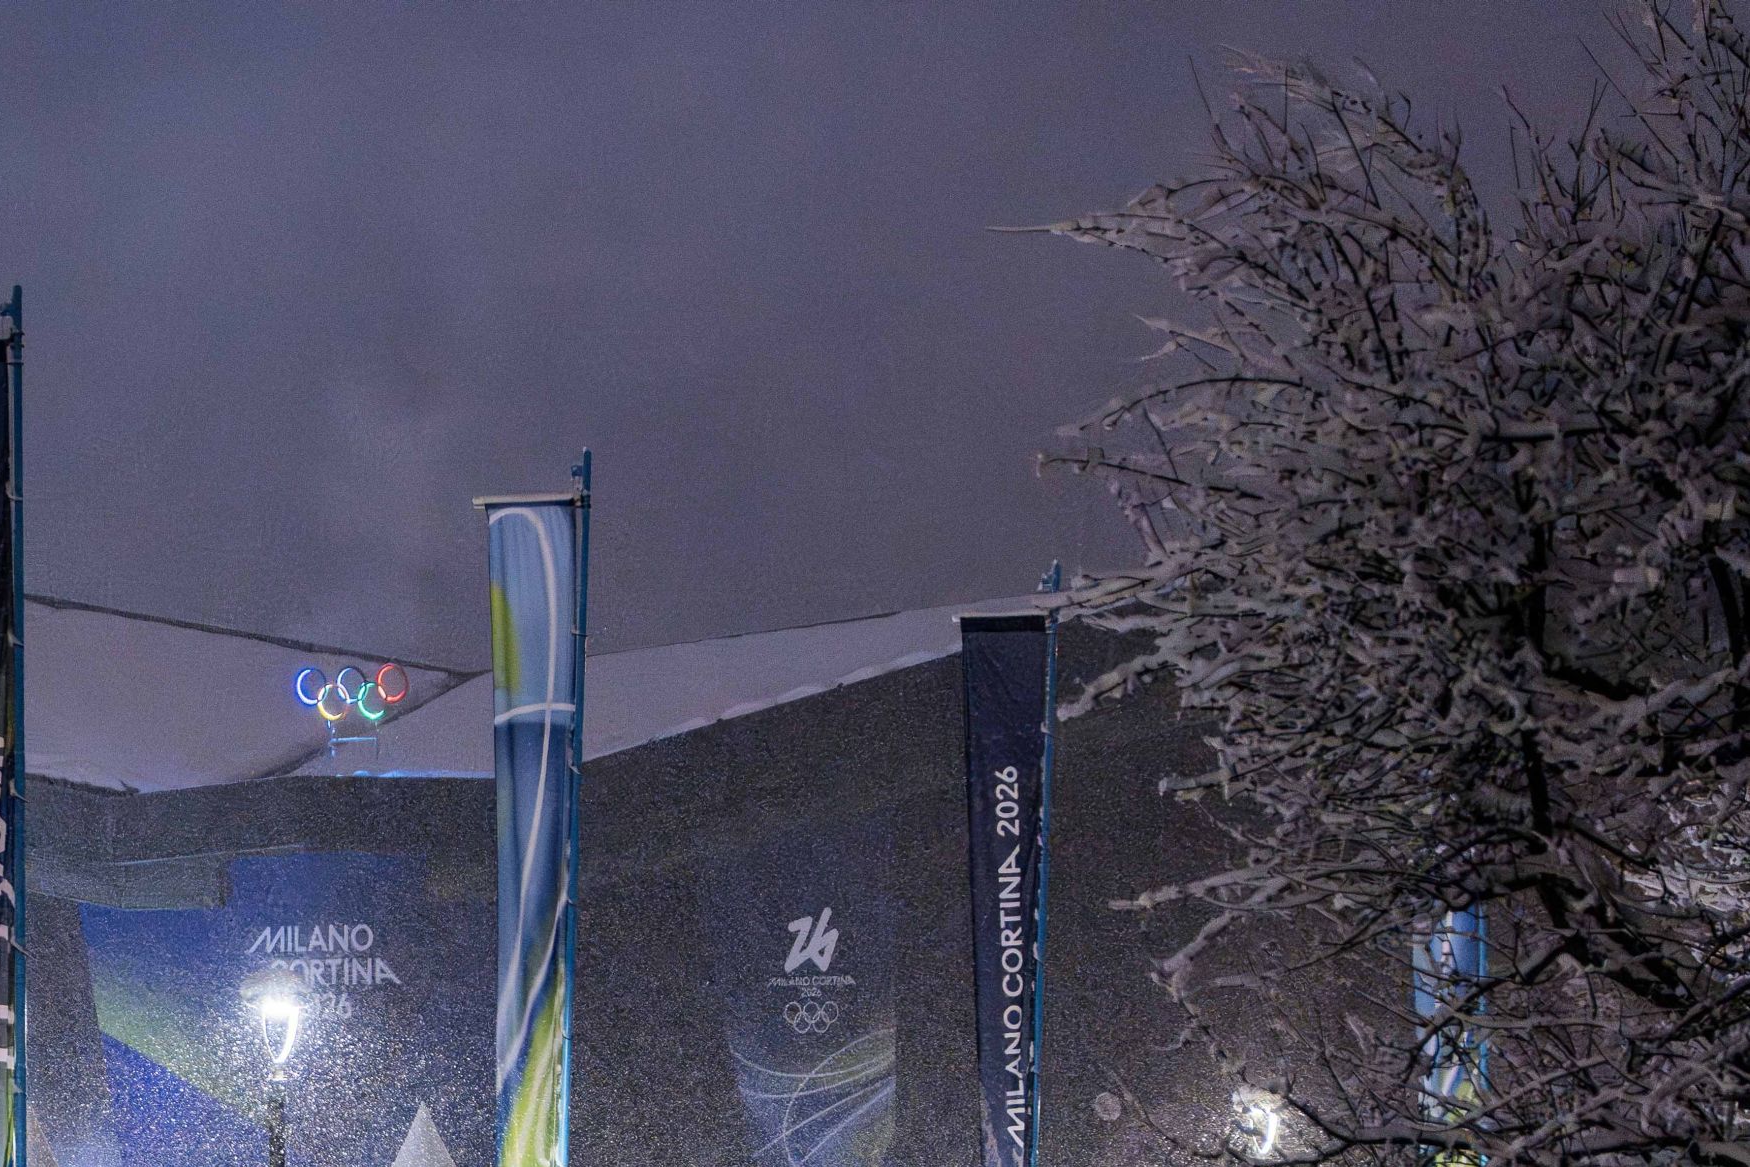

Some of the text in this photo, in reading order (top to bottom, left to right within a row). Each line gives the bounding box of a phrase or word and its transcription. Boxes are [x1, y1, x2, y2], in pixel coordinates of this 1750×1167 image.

[245, 923, 374, 953] MILANO
[994, 765, 1026, 1149] MILANO CORTINA 2026
